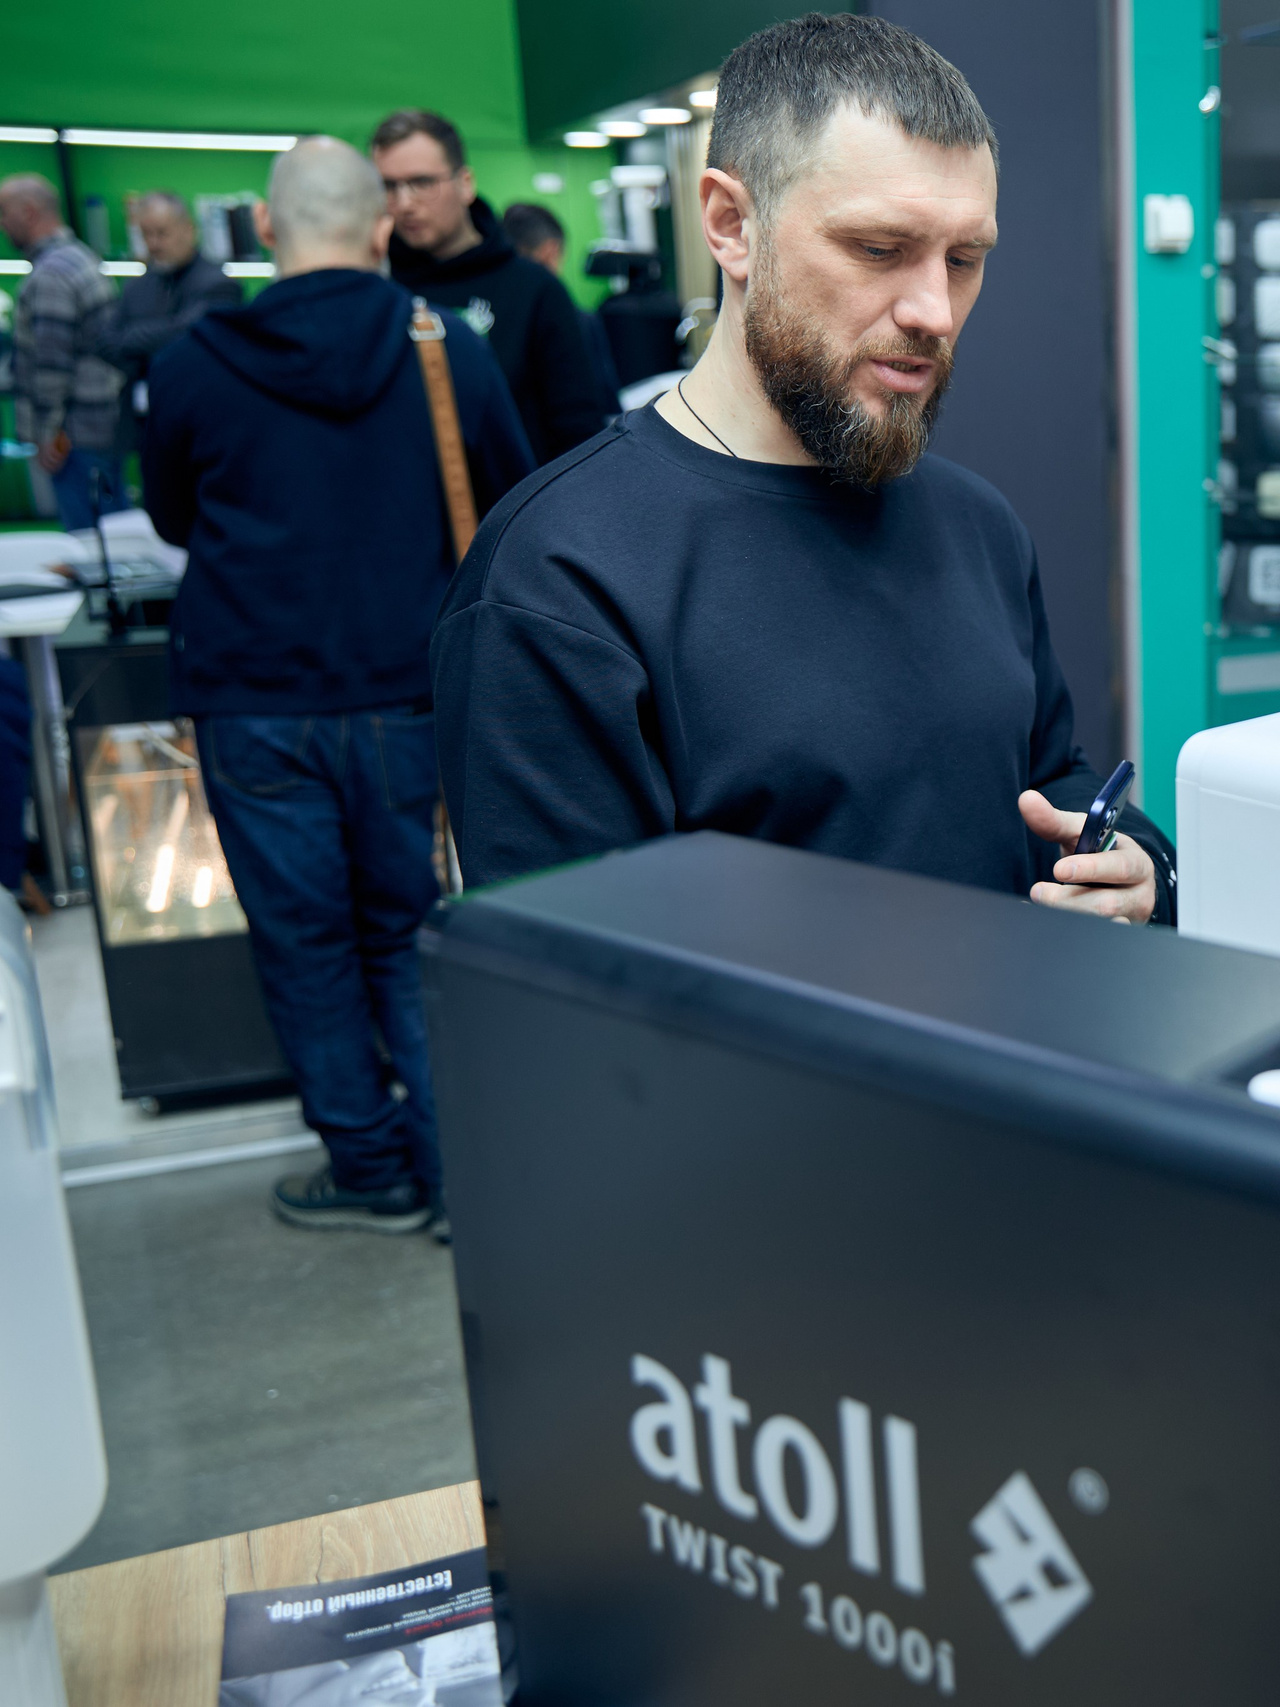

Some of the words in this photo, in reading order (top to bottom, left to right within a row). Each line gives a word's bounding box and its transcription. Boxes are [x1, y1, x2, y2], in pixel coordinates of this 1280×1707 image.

[630, 1352, 926, 1596] atoll
[328, 1569, 453, 1614] Естественный
[641, 1502, 784, 1610] TWIST
[799, 1580, 958, 1696] 1000i
